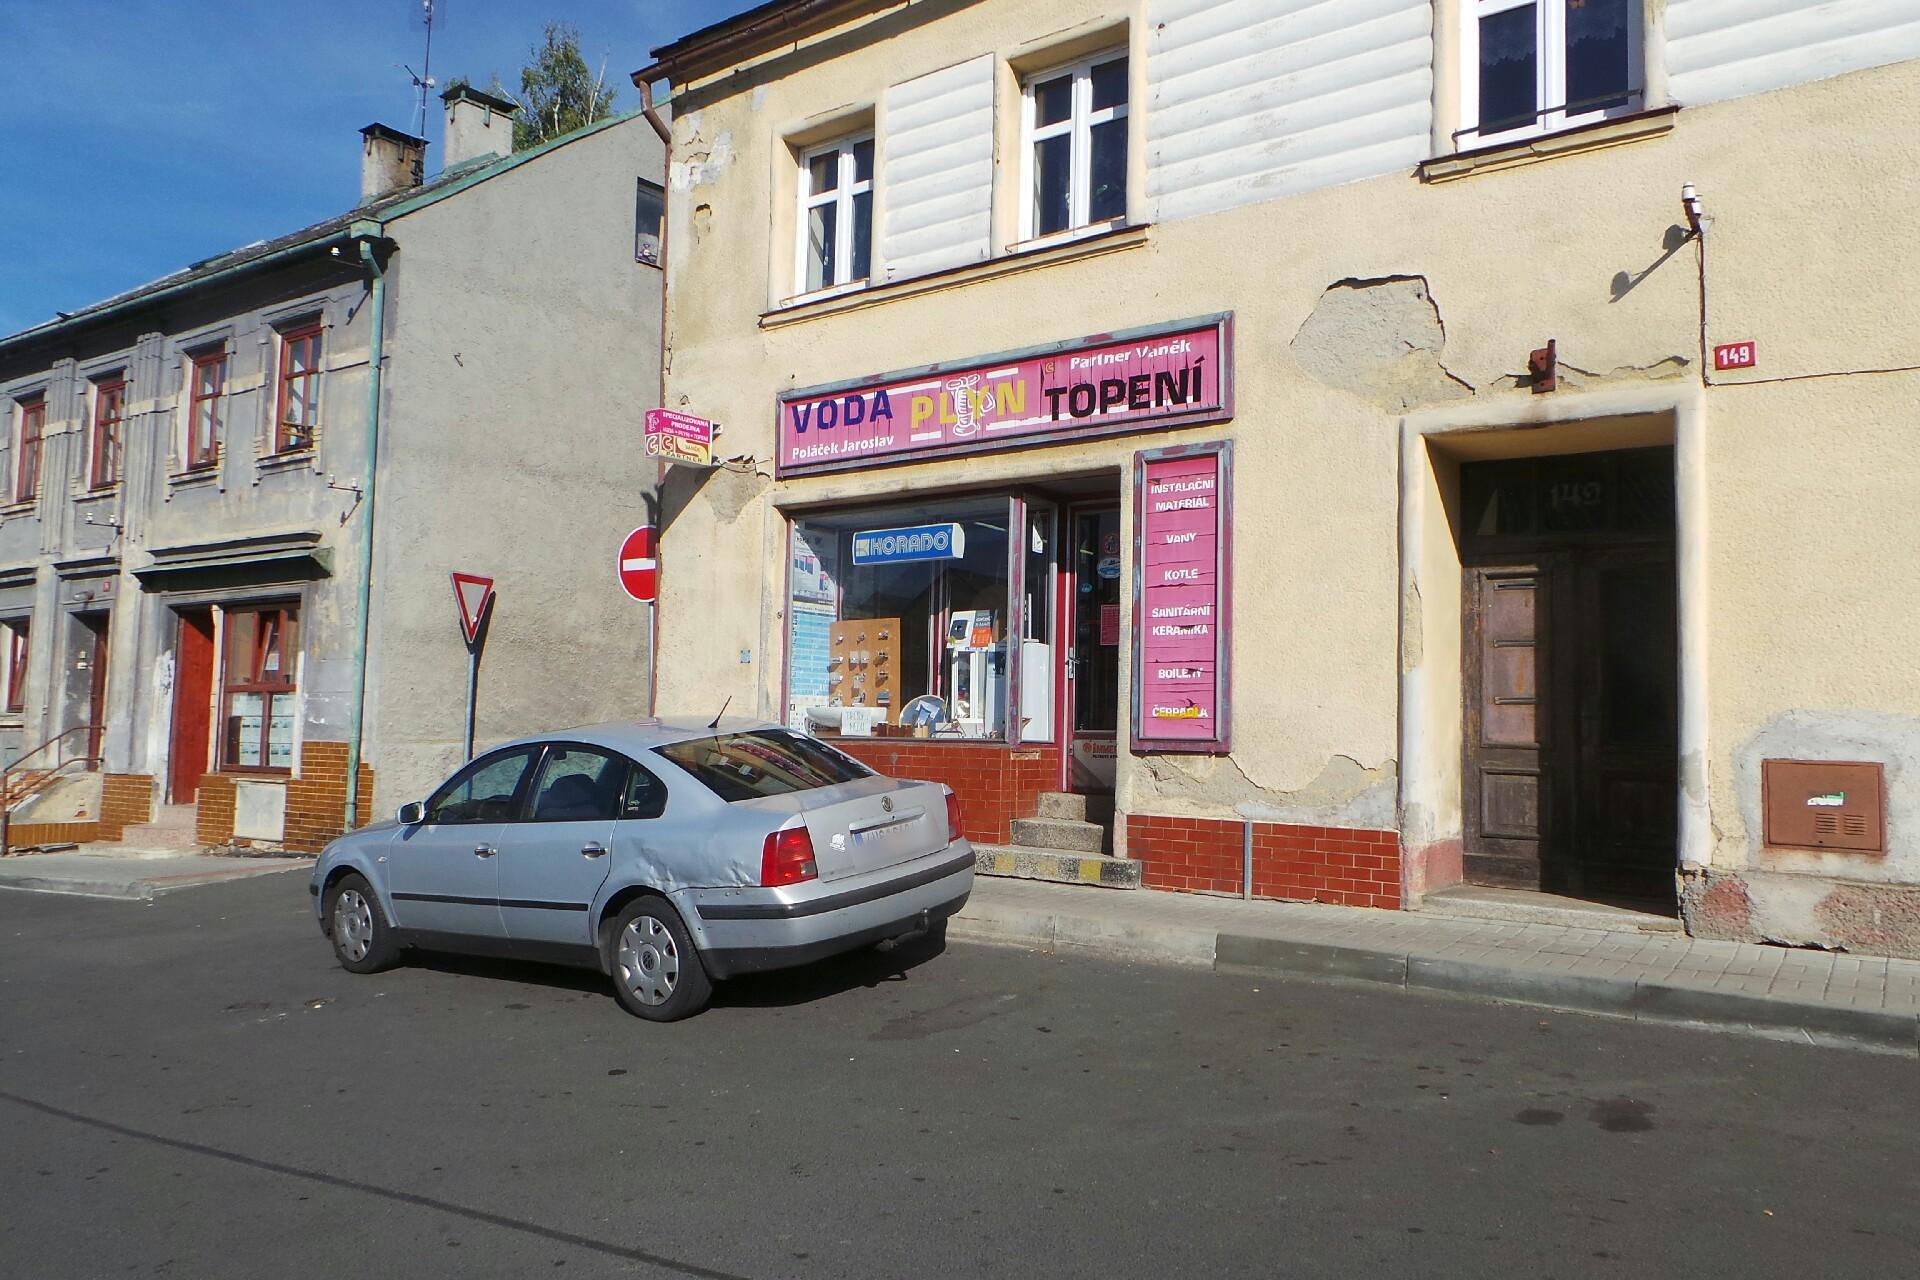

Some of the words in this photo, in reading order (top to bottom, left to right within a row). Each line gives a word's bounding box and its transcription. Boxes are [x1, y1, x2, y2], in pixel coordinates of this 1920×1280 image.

[1070, 350, 1131, 370] Partner
[1136, 339, 1191, 358] Vaněk
[1719, 346, 1750, 366] 149
[792, 389, 893, 434] VODA
[911, 380, 1025, 429] PLYN
[1045, 355, 1205, 422] TOPENÍ
[792, 440, 839, 460] Poláček
[840, 435, 895, 453] Jaroslav
[1150, 476, 1216, 495] INSTALAČNÍ
[1155, 494, 1209, 512] MATERIÁL
[870, 531, 949, 556] KORADO
[1166, 532, 1197, 544] VANY
[1164, 568, 1199, 581] KOTLE
[1151, 603, 1211, 618] SANITÁRNÍ
[1158, 667, 1204, 679] BOILEY
